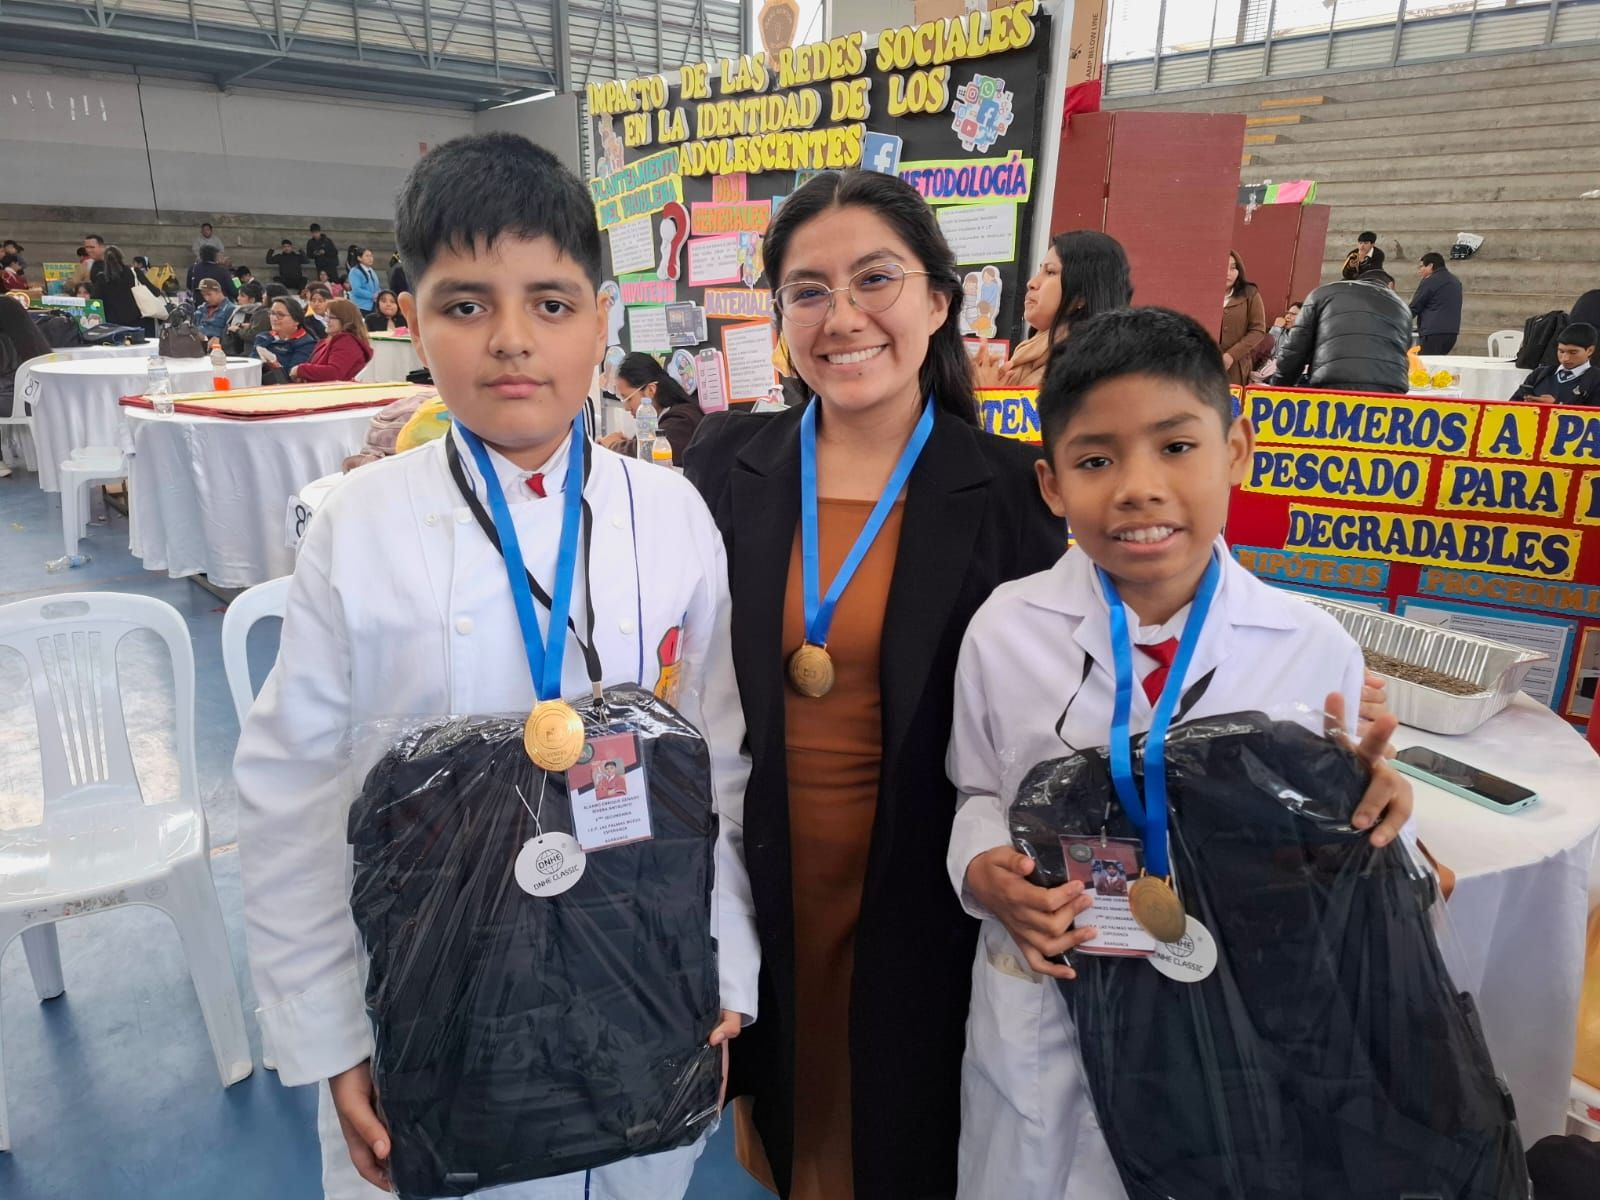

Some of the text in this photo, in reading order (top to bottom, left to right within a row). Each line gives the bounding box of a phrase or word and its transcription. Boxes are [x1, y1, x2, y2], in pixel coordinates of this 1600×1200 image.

[587, 1, 1035, 115] IMPACTO DE LAS REDES SOCIALES
[624, 66, 949, 147] EN LA IDENTIDAD DE LOS
[677, 125, 864, 177] ADOLESCENTES
[1251, 397, 1467, 452] POLIMEROS
[1489, 413, 1522, 455] A
[1250, 451, 1419, 499] PESCADO
[1449, 466, 1558, 513] PARA
[1236, 550, 1382, 588] HIPÓTESIS
[1287, 510, 1570, 575] DEGRADABLES
[538, 853, 562, 870] DNHE
[552, 864, 580, 882] CLASSIC
[1173, 955, 1204, 973] CLASSIC
